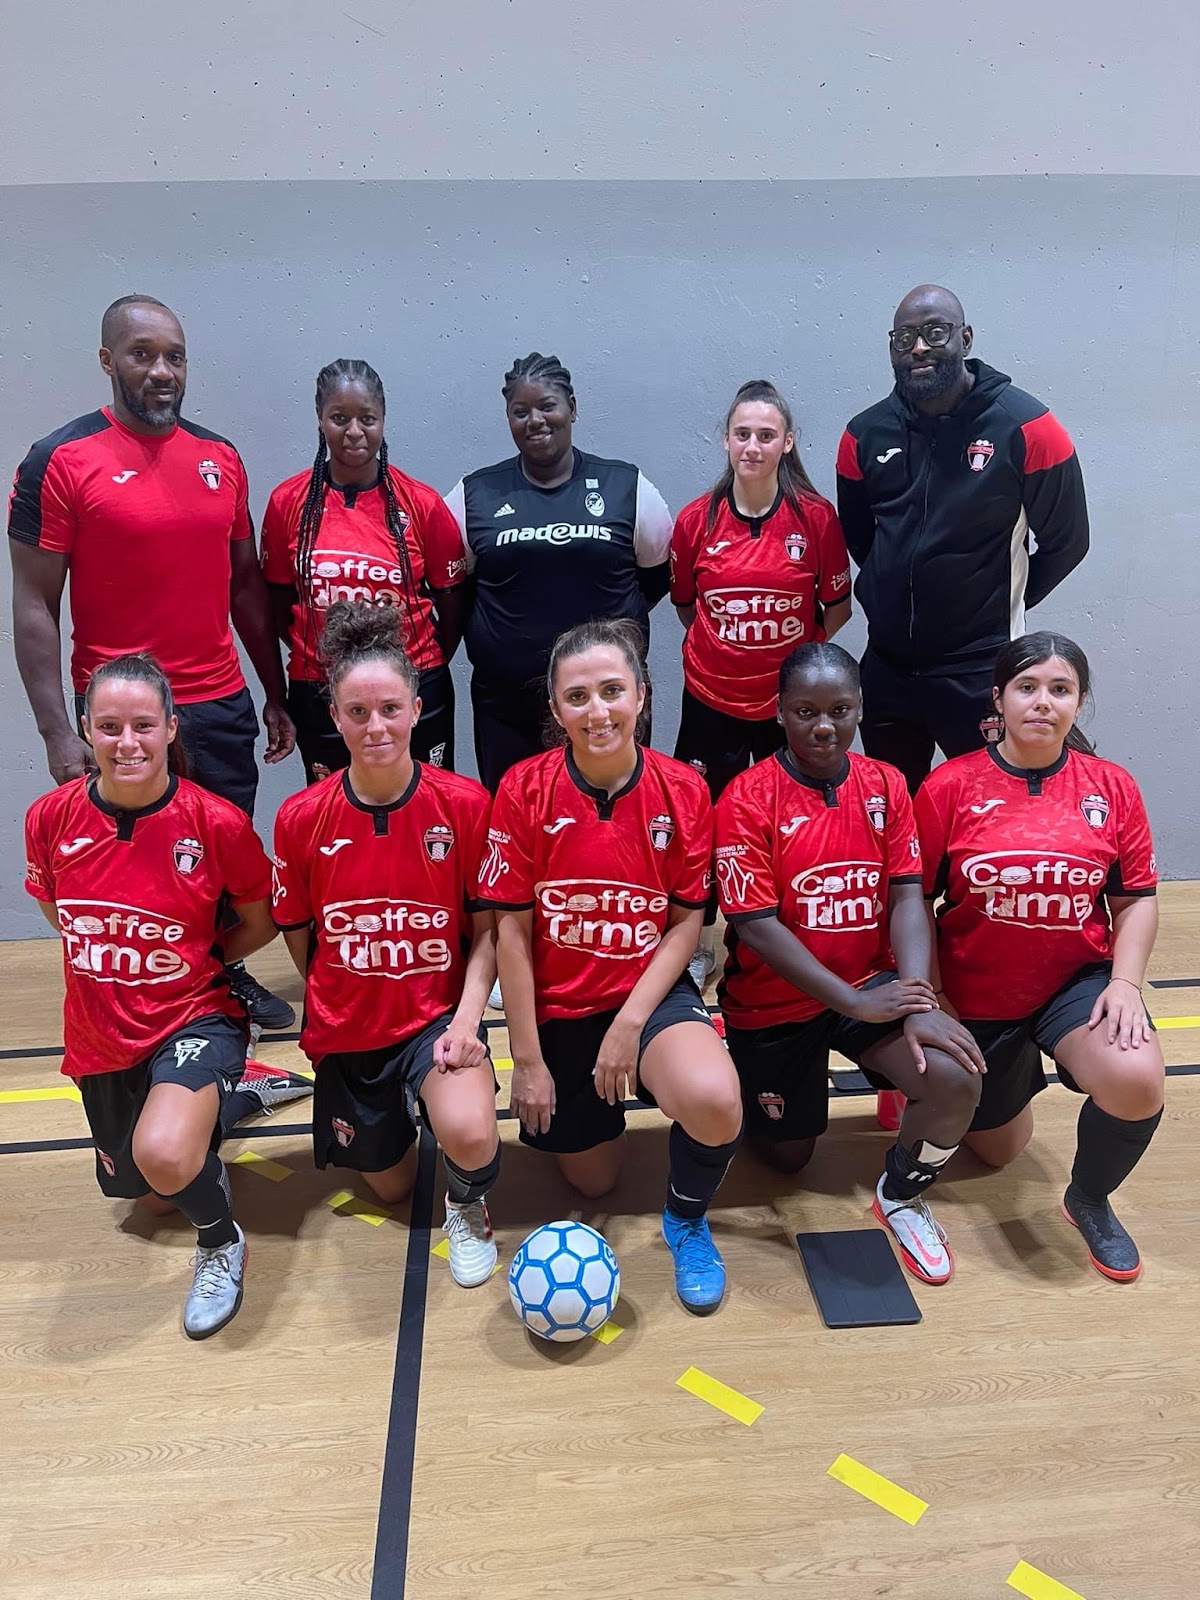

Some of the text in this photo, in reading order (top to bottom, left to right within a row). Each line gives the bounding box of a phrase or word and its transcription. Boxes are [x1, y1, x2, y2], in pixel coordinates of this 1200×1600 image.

[496, 522, 612, 547] madewis
[709, 594, 803, 615] Coffee
[710, 611, 802, 641] Time
[969, 860, 1104, 886] Coffee
[541, 888, 668, 913] Coffee
[969, 886, 1090, 919] Time
[57, 908, 184, 943] Coffee
[324, 906, 450, 934] Coffee
[541, 910, 658, 948] Time
[61, 930, 182, 975] Time
[325, 934, 448, 969] Time
